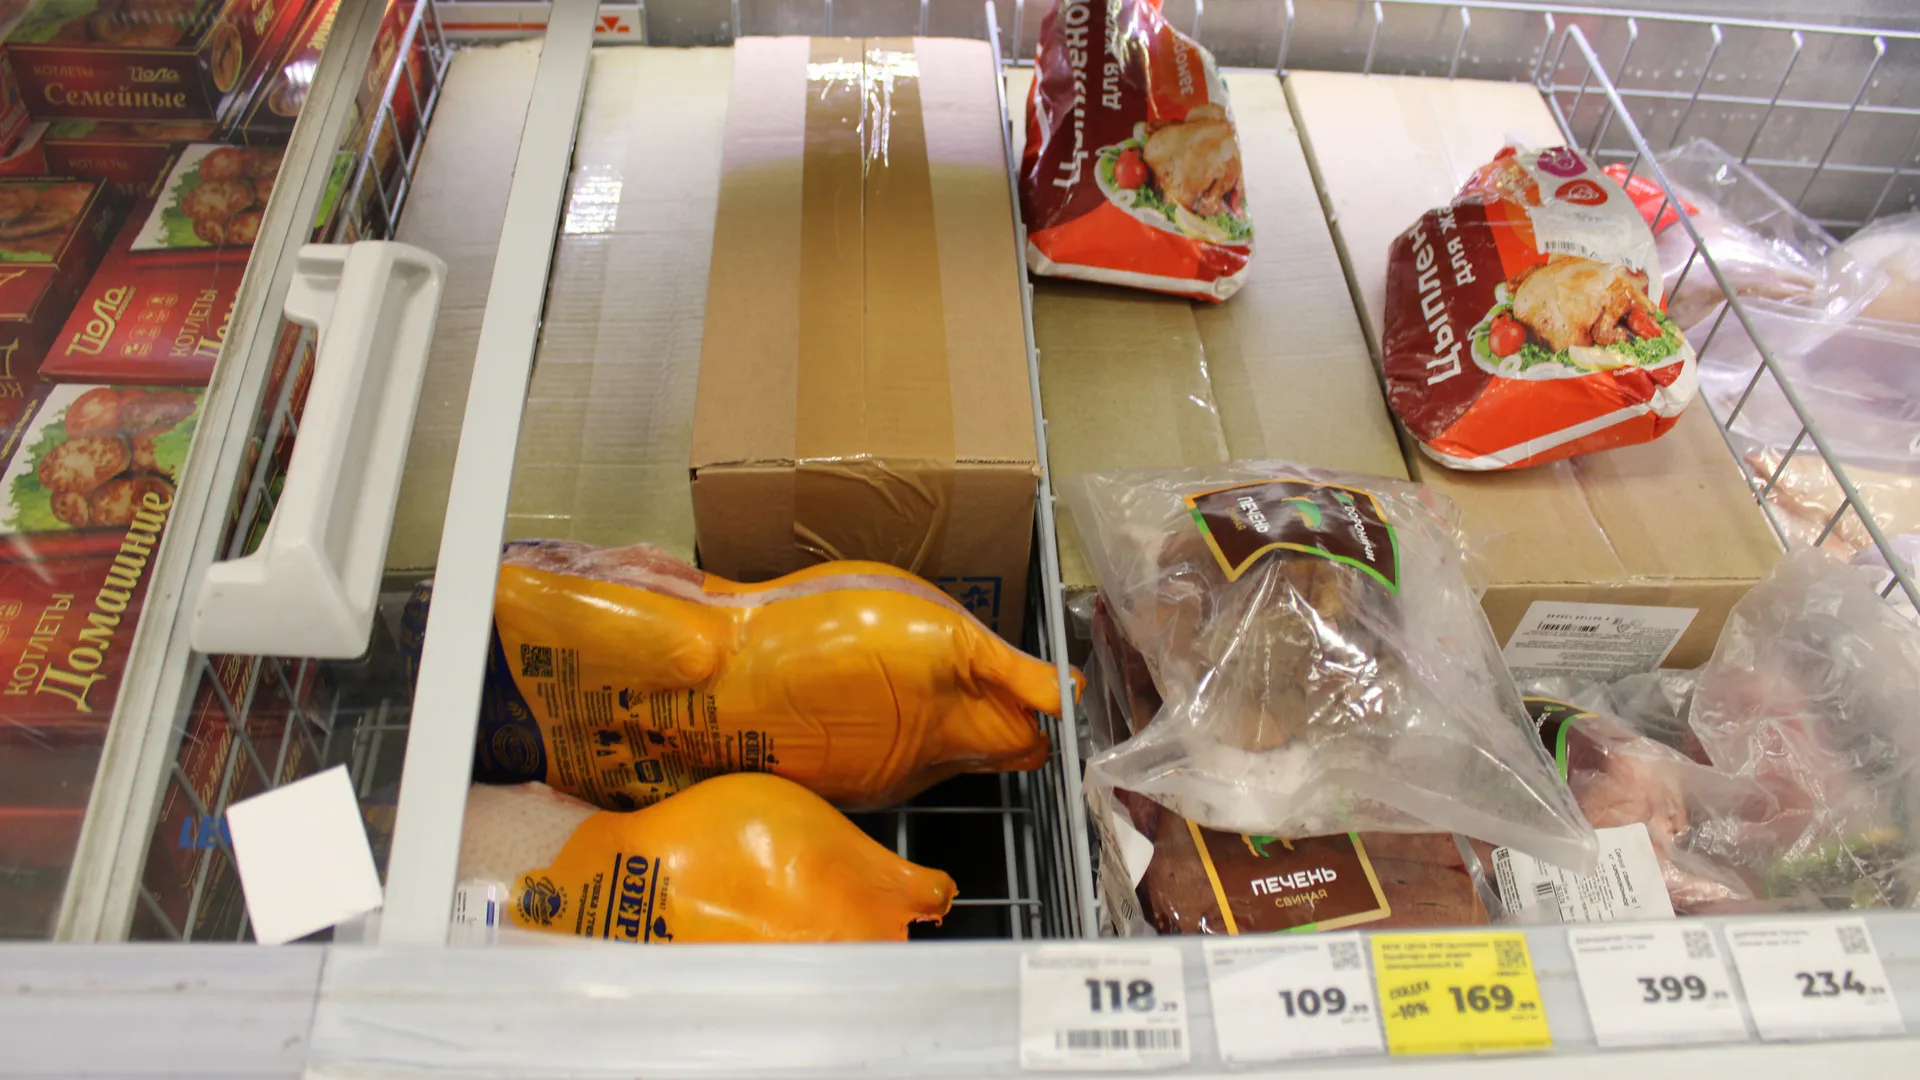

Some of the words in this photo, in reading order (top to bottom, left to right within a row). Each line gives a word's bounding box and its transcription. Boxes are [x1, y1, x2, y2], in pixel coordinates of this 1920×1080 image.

[44, 83, 187, 109] Семейные
[1102, 63, 1122, 110] для
[1446, 235, 1477, 287] для
[169, 288, 219, 357] КОТЛЕТЫ
[34, 491, 173, 713] Домашние
[3, 593, 75, 696] КОТЛЕТЫ
[615, 854, 649, 943] ОЗЁР
[1250, 867, 1337, 896] ПЕЧЕНЬ
[1275, 888, 1328, 908] СВИНАЯ
[1085, 977, 1156, 1013] 118
[1447, 984, 1514, 1014] 169
[1637, 975, 1708, 1005] 399
[1796, 970, 1868, 998] 234
[1278, 987, 1347, 1019] 109
